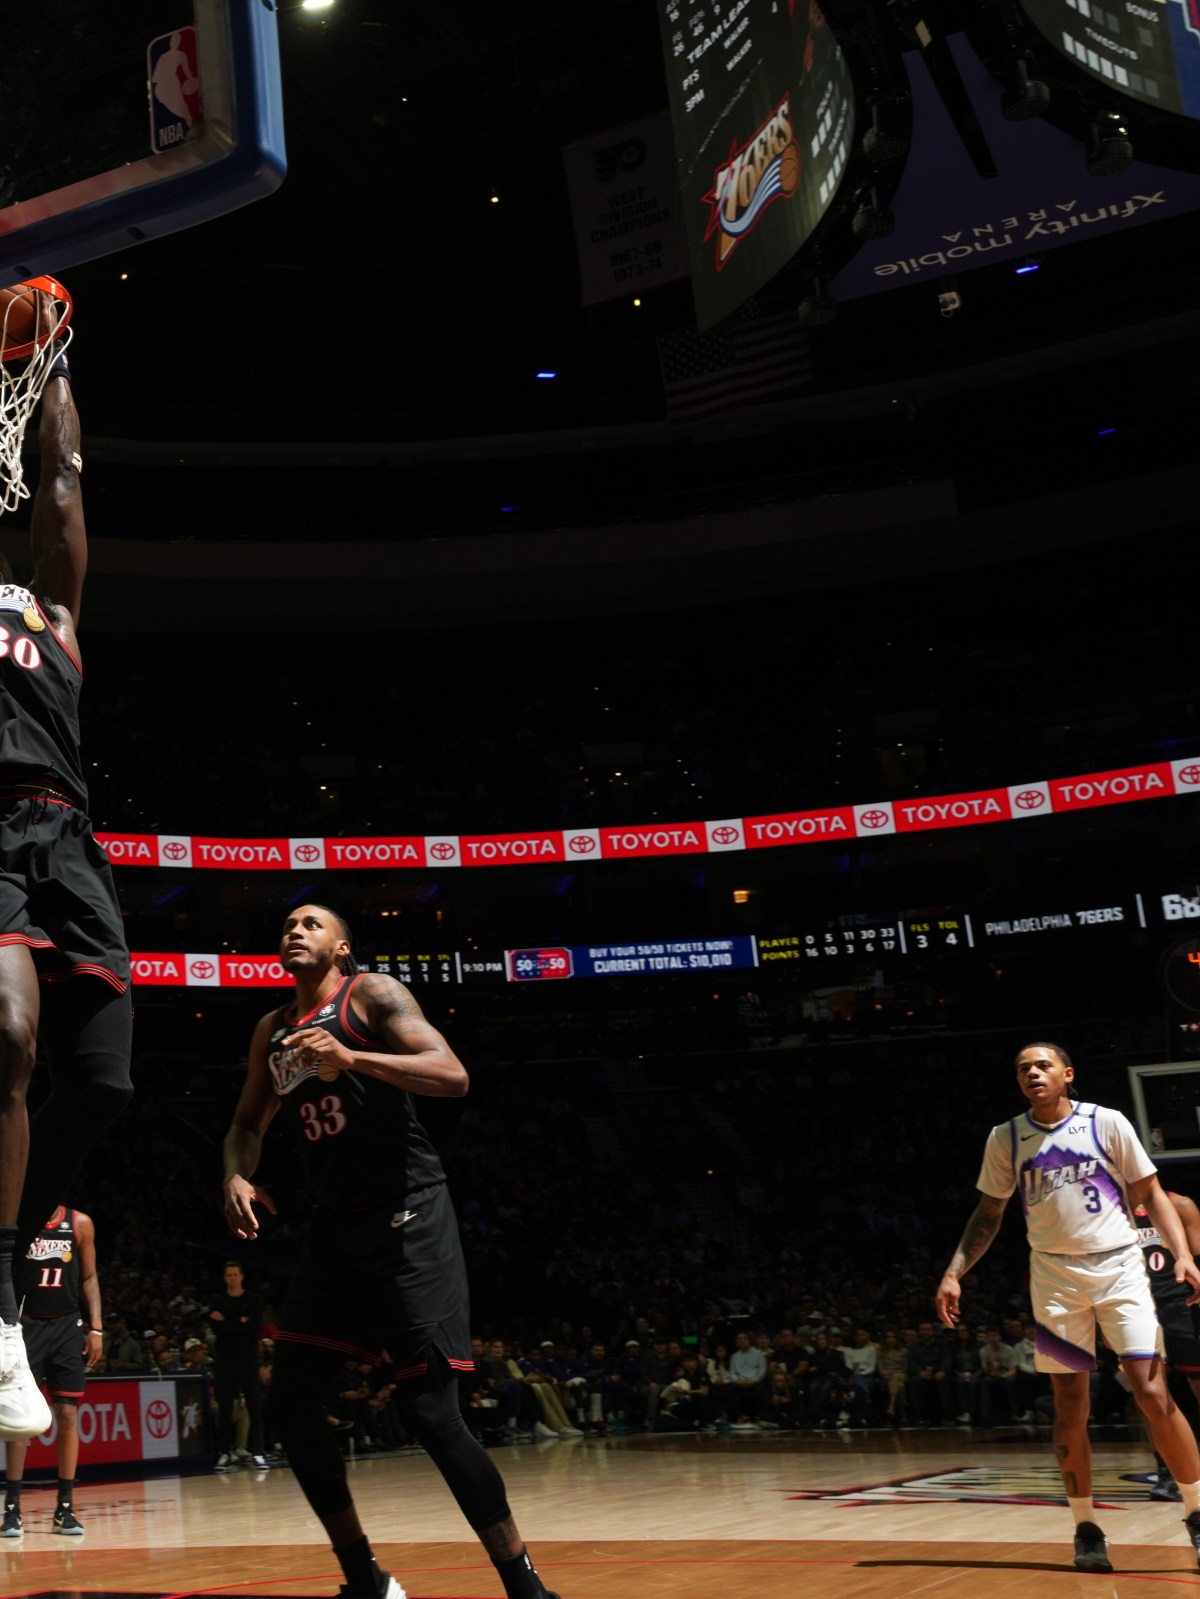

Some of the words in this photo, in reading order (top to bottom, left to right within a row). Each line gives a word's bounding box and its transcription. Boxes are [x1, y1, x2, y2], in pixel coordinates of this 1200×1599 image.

[1125, 2, 1160, 23] BONUS
[686, 23, 723, 64] TEAM
[682, 69, 700, 91] PTS
[158, 121, 185, 147] NBA
[607, 186, 645, 209] WEST
[598, 197, 660, 228] DIVISION
[941, 199, 1079, 244] ARENA
[1024, 190, 1167, 242] xfinity
[590, 207, 672, 244] CHAMPIONS
[873, 233, 1014, 278] mobile
[200, 845, 281, 862] TOYOTA
[333, 845, 417, 860] TOYOTA
[468, 840, 555, 858] TOYOTA
[609, 831, 698, 849] TOYOTA
[752, 816, 846, 839] TOYOTA
[903, 798, 1001, 822] TOYOTA
[1060, 773, 1163, 801] TOYOTA
[985, 914, 1073, 936] PHILADELPHIA
[1075, 906, 1124, 925] 76ERS
[759, 937, 799, 948] PLAYER
[805, 935, 814, 945] 0
[843, 931, 854, 941] 11
[860, 929, 876, 939] 30
[880, 927, 895, 938] 33
[916, 934, 928, 949] 3
[945, 933, 958, 945] 4
[762, 949, 800, 961] POINTS
[805, 948, 819, 958] 16
[824, 946, 838, 956] 10
[882, 941, 895, 950] 17
[225, 961, 297, 980] TOYO
[377, 963, 391, 973] 25
[398, 963, 411, 972] 16
[420, 963, 428, 972] 3
[441, 962, 449, 971] 4
[462, 963, 485, 973] 9:10
[486, 963, 503, 972] PM
[517, 958, 532, 971] 50
[549, 957, 566, 969] 50
[593, 958, 647, 973] CURRENT
[399, 974, 412, 983] 14
[423, 974, 429, 983] 1
[441, 973, 450, 982] 5
[300, 1094, 347, 1142] 33
[1023, 1158, 1102, 1207] UTAH
[1082, 1186, 1102, 1214] 3
[37, 1267, 63, 1288] 11
